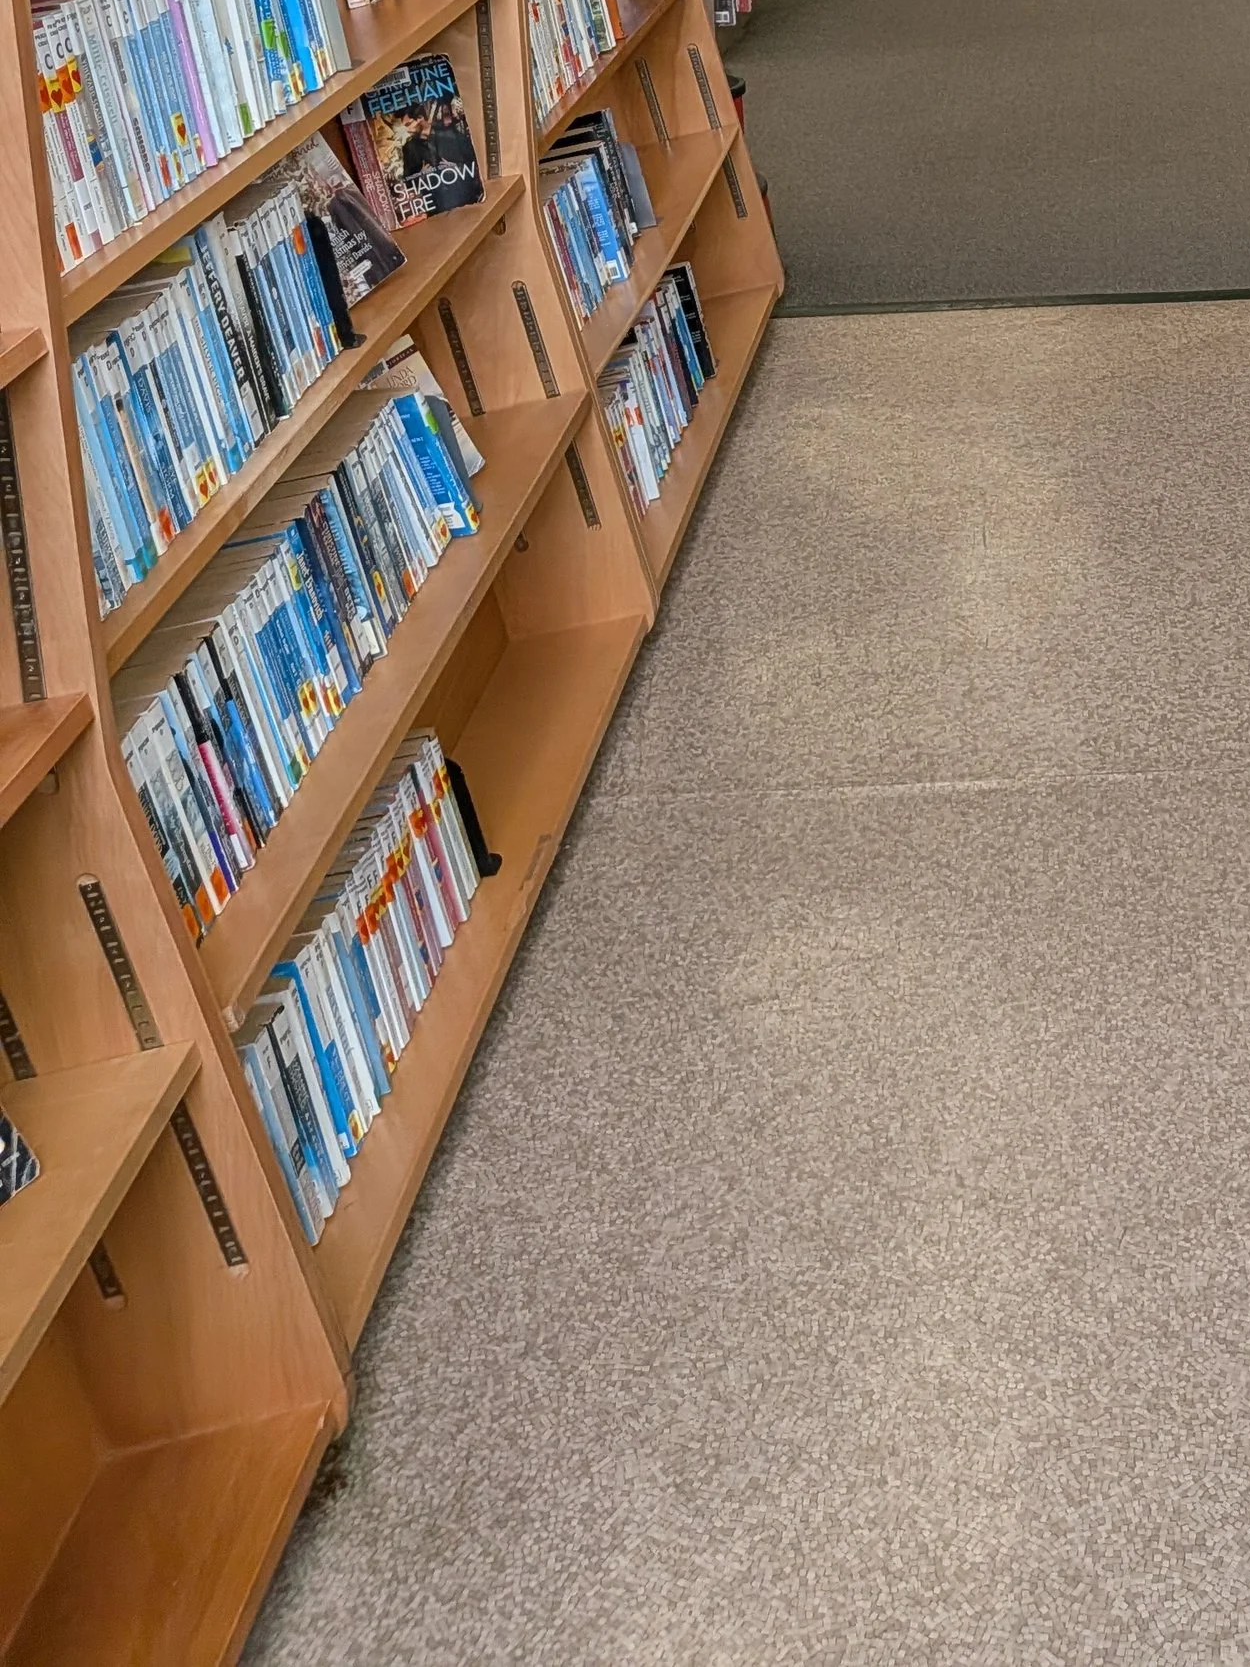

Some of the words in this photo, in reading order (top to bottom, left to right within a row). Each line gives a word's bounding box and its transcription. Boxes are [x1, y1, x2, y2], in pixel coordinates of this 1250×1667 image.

[368, 77, 455, 117] FEEHAN
[362, 172, 373, 193] FIRE
[371, 171, 391, 214] SHADOW
[394, 162, 476, 201] SHADOW
[400, 195, 437, 221] FIRE
[357, 228, 367, 244] Joy
[200, 246, 227, 312] JEFFERY
[221, 319, 245, 381] DEAVER
